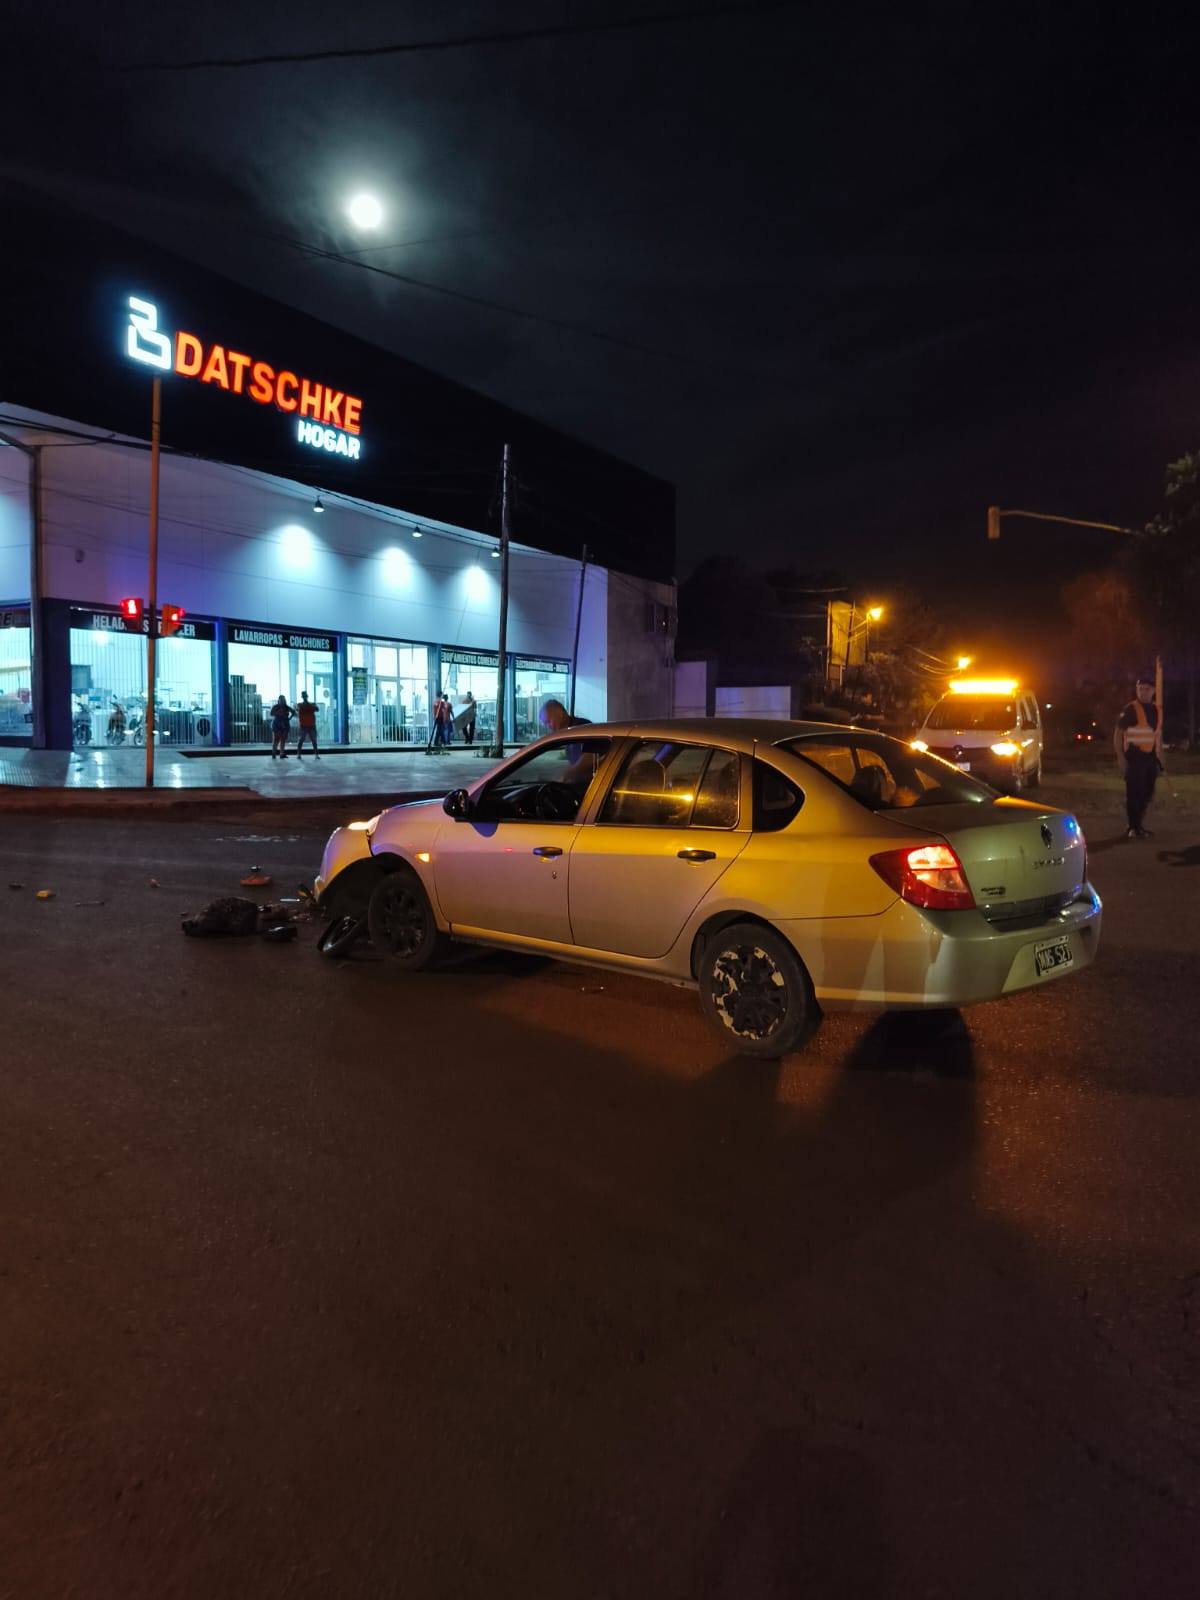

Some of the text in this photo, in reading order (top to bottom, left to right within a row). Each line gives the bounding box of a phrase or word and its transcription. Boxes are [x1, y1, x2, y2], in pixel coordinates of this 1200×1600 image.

[175, 331, 362, 435] DATSCHKE
[298, 419, 361, 460] HOGAR
[93, 614, 149, 633] HELADS
[234, 629, 283, 646] LAVARROPAS
[290, 635, 330, 650] COLCHONES
